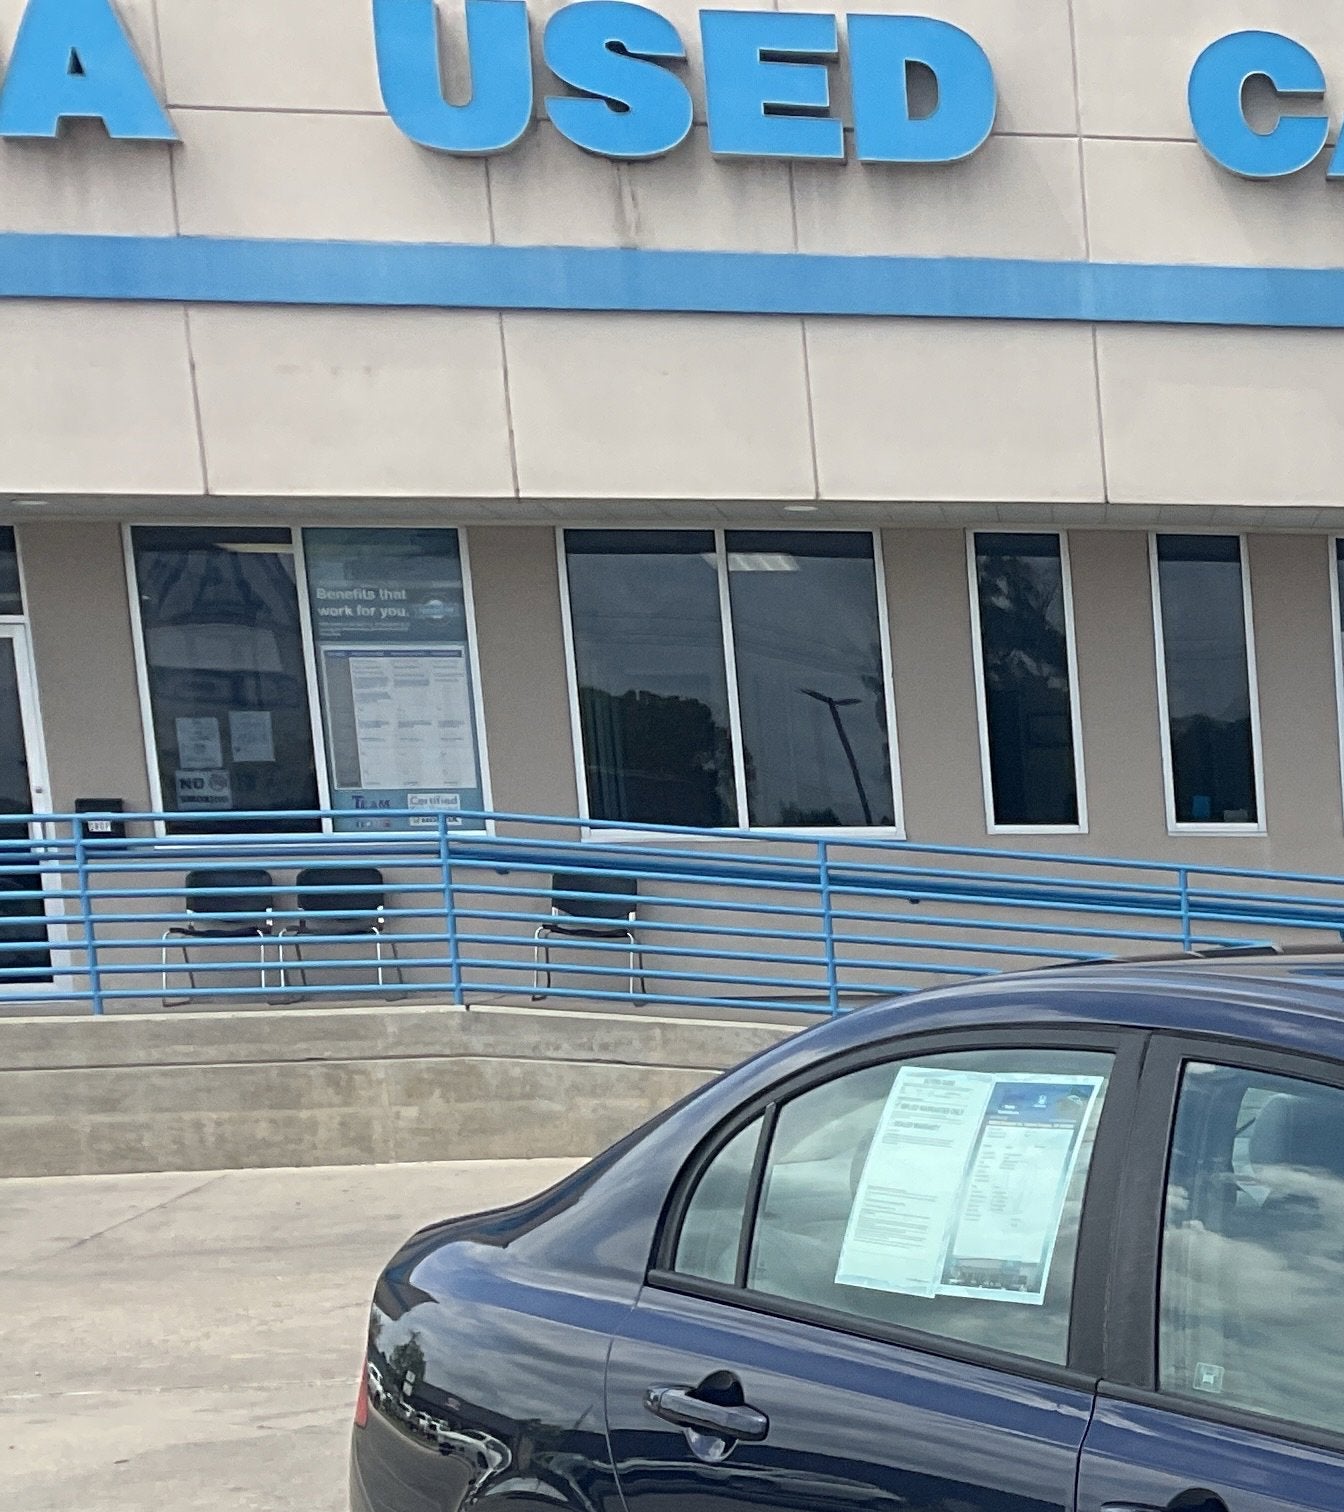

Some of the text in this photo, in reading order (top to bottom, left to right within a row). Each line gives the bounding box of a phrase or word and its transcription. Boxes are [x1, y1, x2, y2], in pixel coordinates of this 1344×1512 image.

[0, 0, 183, 143] A
[373, 0, 996, 164] USED
[315, 587, 407, 600] Benefits that
[317, 604, 353, 616] work
[356, 604, 376, 616] for
[180, 778, 205, 790] NO
[409, 795, 459, 805] Certified
